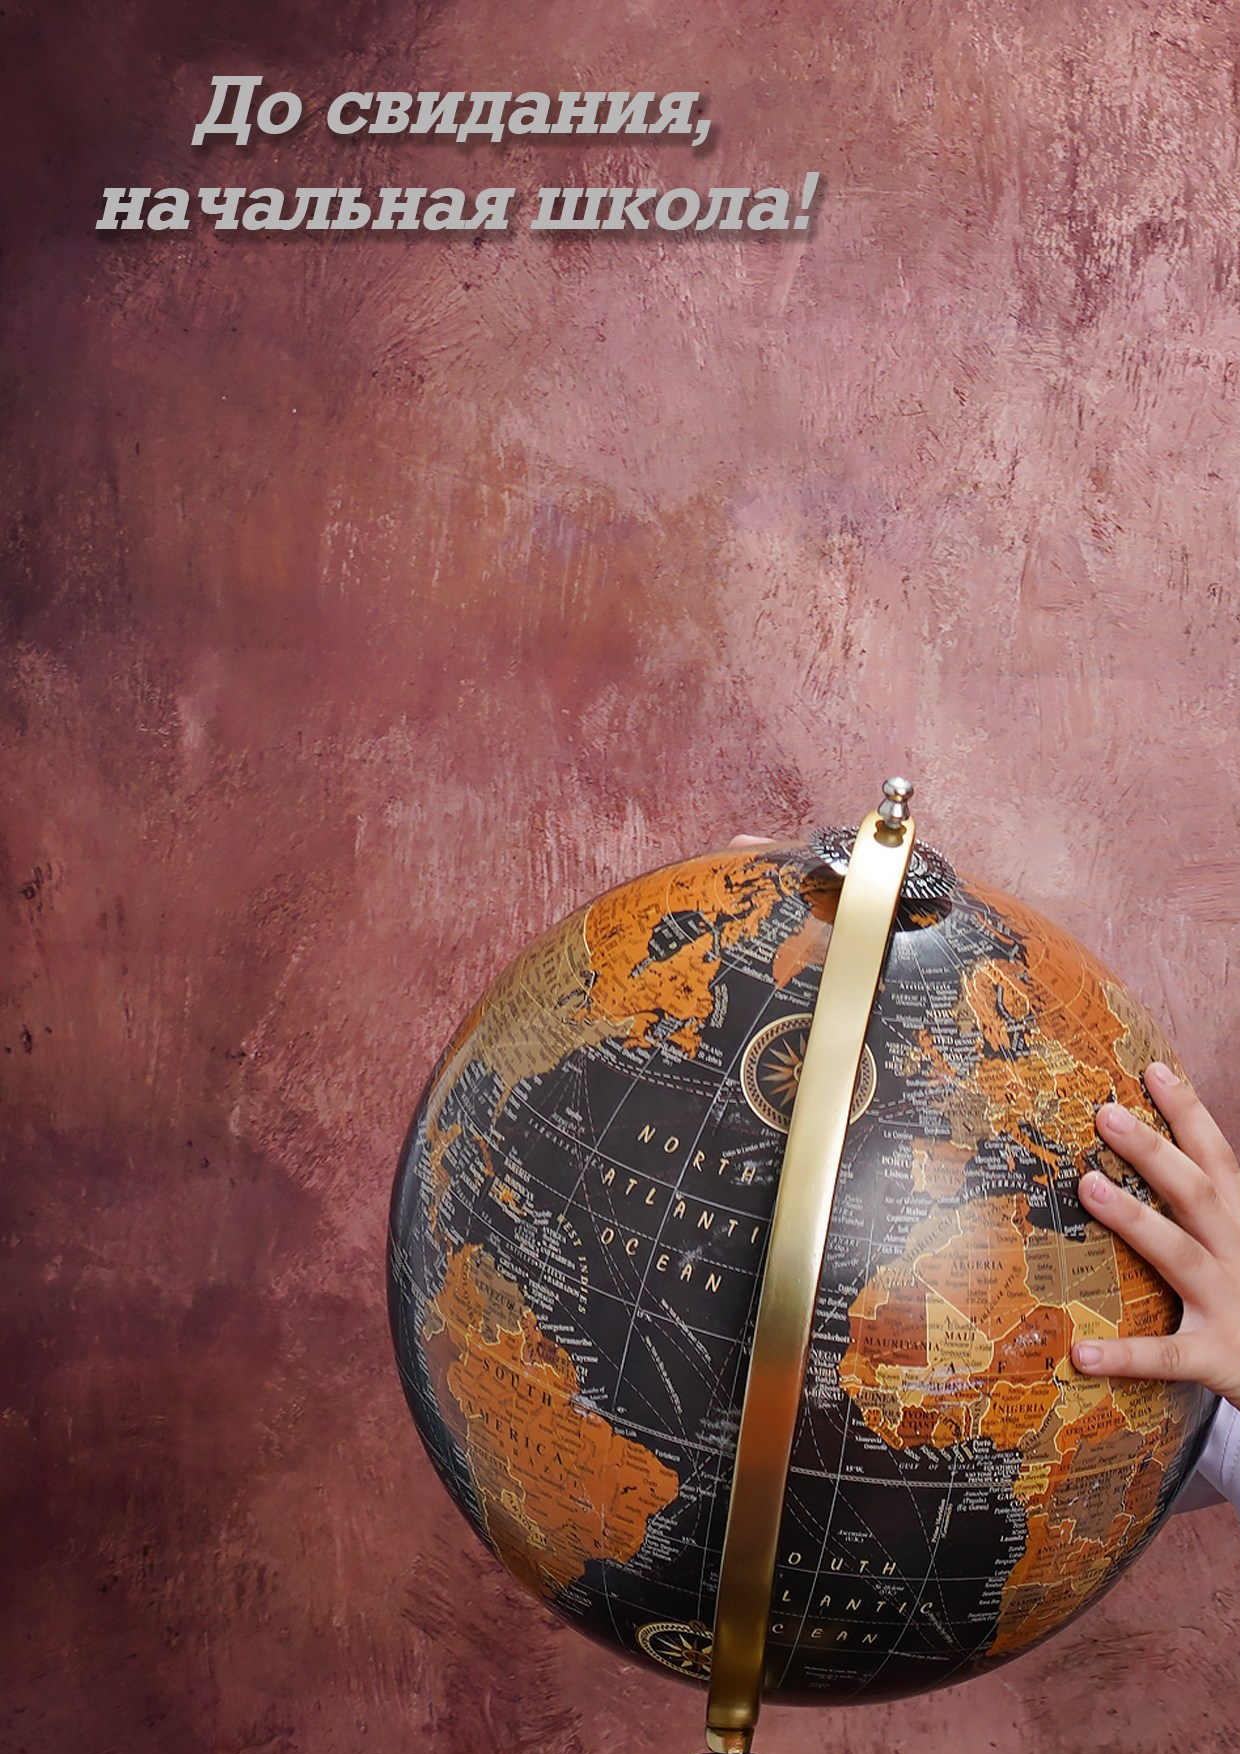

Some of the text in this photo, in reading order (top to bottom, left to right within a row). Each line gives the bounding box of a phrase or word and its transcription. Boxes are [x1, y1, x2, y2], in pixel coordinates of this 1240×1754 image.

[637, 1124, 757, 1184] NORTH
[602, 1167, 761, 1245] ATLANTI
[600, 1226, 722, 1294] OCEAN
[483, 1359, 553, 1408] SOUTH
[788, 1552, 897, 1576] OUTH
[782, 1590, 934, 1615] LANTIC
[772, 1623, 878, 1645] CEAN
